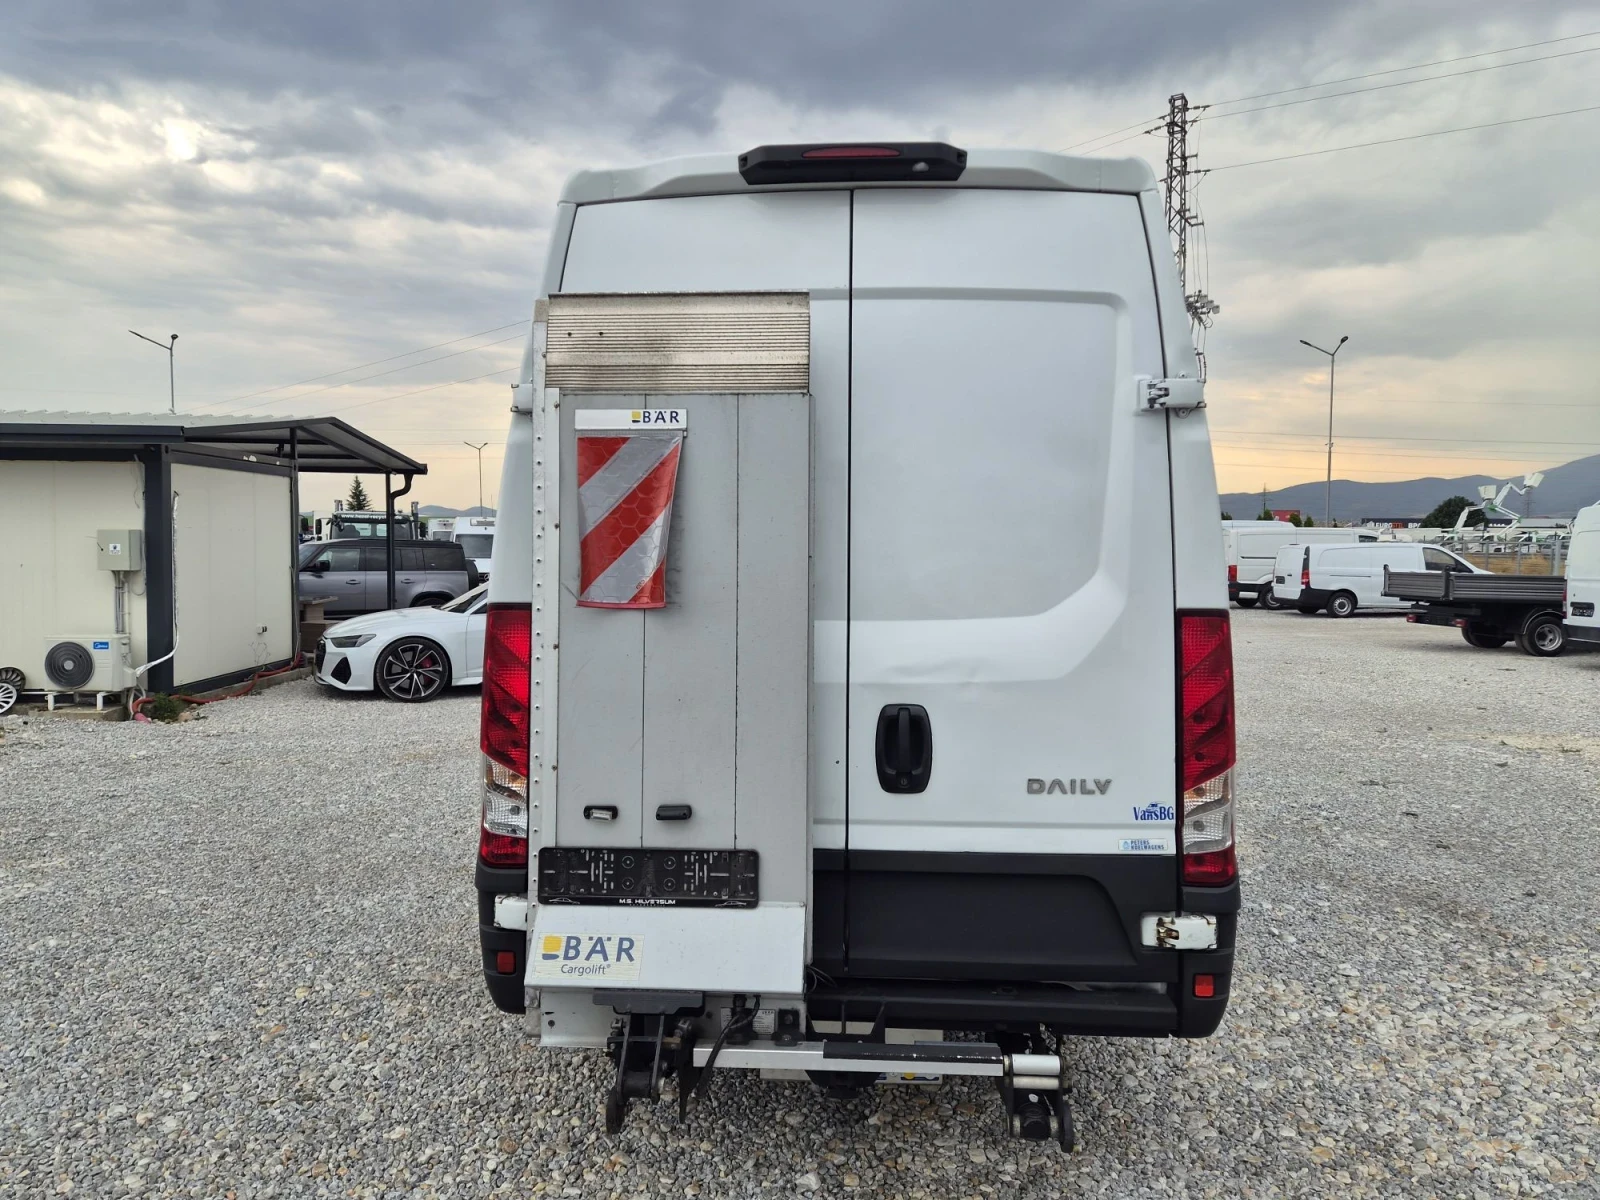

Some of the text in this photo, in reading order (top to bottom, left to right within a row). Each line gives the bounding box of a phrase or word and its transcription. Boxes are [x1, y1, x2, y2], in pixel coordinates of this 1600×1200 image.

[642, 410, 680, 423] BÄR
[1026, 778, 1113, 795] DAILY
[1133, 805, 1174, 821] VansBG
[562, 935, 635, 962] BÄR
